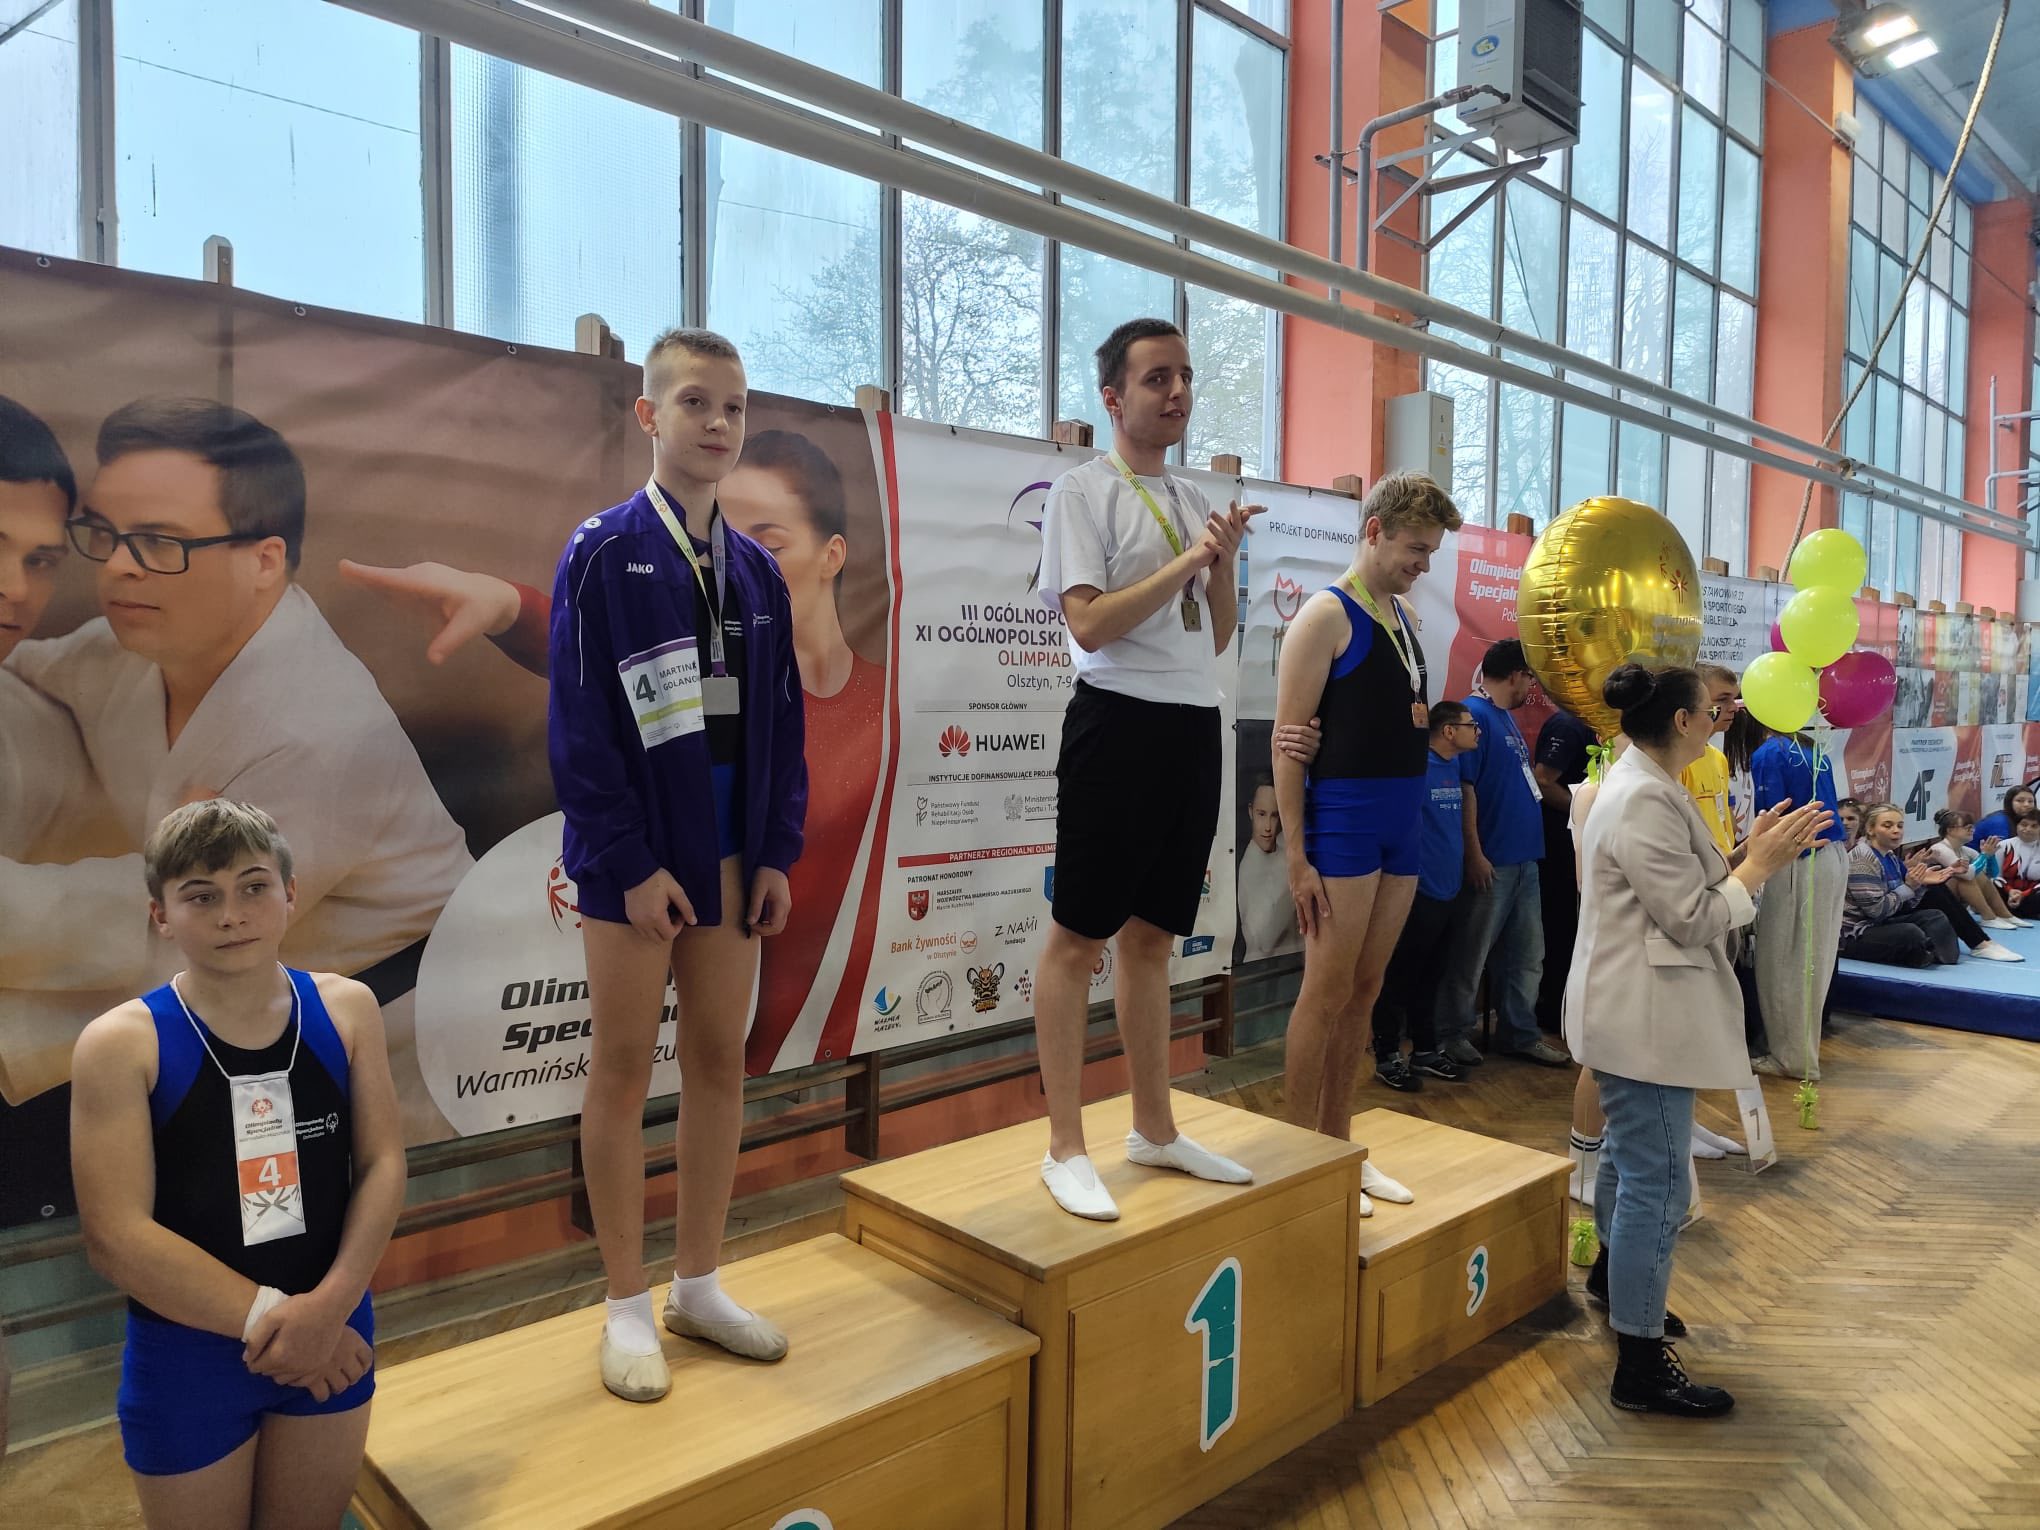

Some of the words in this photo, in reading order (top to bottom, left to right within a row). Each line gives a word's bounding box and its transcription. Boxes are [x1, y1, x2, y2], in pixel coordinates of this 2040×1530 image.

[1269, 521, 1302, 537] PROJEKT
[626, 562, 654, 574] JAKO
[961, 604, 978, 621] III
[1708, 601, 1747, 614] SPORTOEGO
[915, 624, 931, 642] XI
[938, 622, 1062, 647] OGÓLNOPOLSKI
[998, 650, 1072, 668] OLIMPIAD
[1007, 674, 1053, 691] Olsztyn,
[968, 702, 1000, 710] SPONSOR
[1000, 701, 1027, 710] GŁÓWNY
[975, 733, 1045, 752] HUAWEI
[929, 773, 970, 783] INSTYTUCJE
[971, 771, 1033, 781] DOFINANSOWUJĄCE
[1024, 805, 1043, 814] Sportu
[949, 851, 991, 862] PARTNERZY
[991, 846, 1035, 857] REGIONALNI
[907, 874, 939, 884] PATRONAT
[939, 870, 973, 881] HONOROWY
[890, 938, 913, 954] Bank
[914, 931, 957, 952] Żywności
[1004, 937, 1026, 946] fundacja
[933, 949, 957, 961] Olsztynie
[258, 1156, 281, 1186] 4
[1467, 1245, 1489, 1317] 3
[1185, 1256, 1242, 1452] 1
